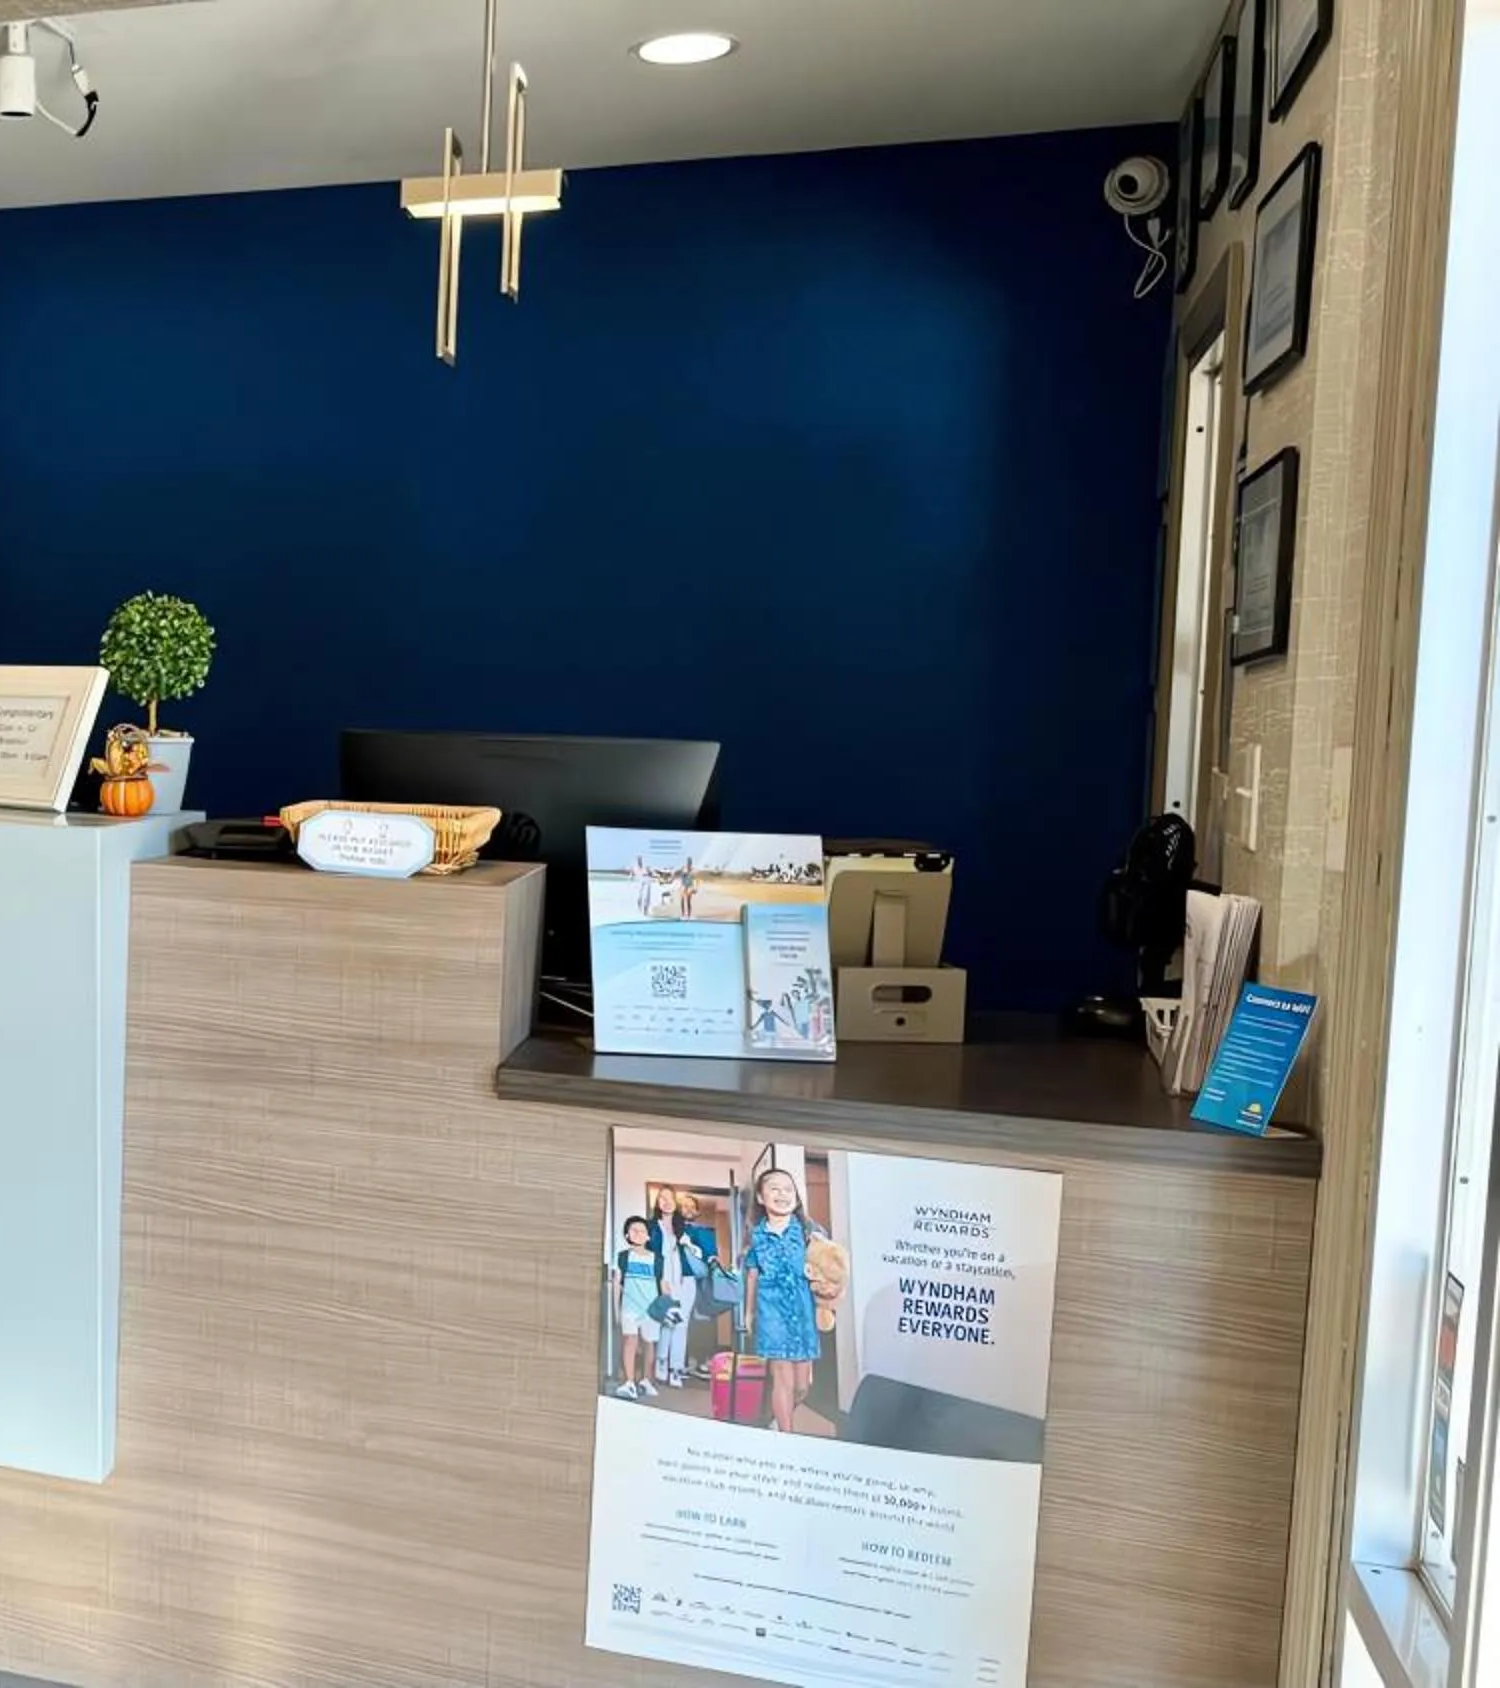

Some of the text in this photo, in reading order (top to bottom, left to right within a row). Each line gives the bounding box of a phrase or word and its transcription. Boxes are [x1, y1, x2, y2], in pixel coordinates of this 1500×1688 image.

[915, 1205, 991, 1223] WYNDHAM
[914, 1220, 990, 1238] REWARDS
[883, 1253, 927, 1268] vacation
[895, 1239, 1005, 1263] Whether you're on a
[899, 1277, 995, 1306] WYNDHAM
[903, 1298, 990, 1325] REWARDS
[897, 1317, 995, 1346] EVERYONE.
[861, 1541, 889, 1555] HOW
[891, 1546, 905, 1559] TO
